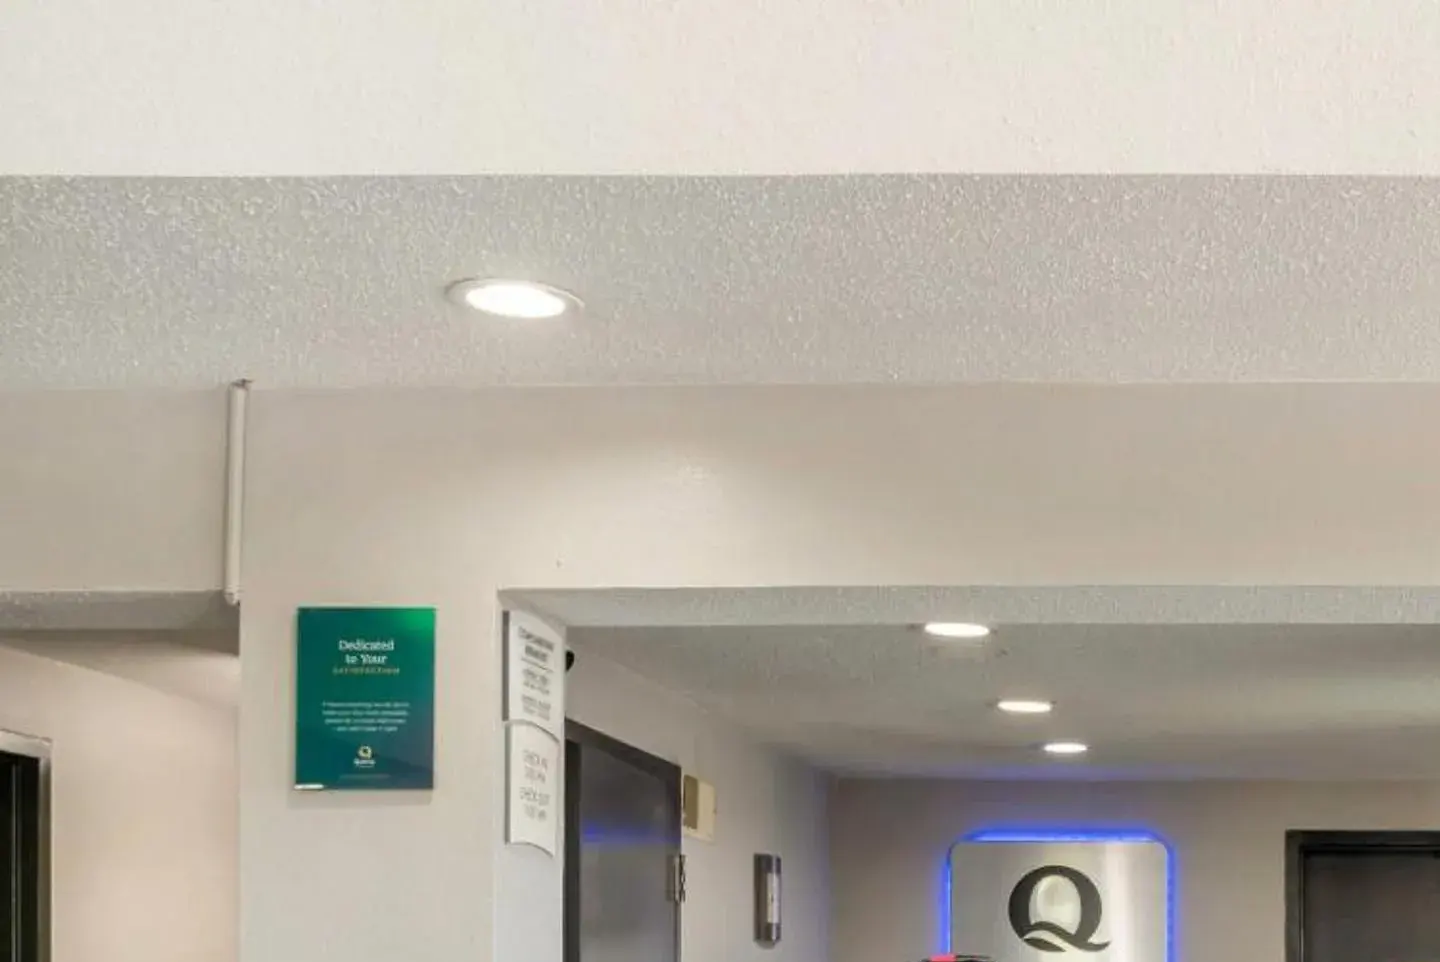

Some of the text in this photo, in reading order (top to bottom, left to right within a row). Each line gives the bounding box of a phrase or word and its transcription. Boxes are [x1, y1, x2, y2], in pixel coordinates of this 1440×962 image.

[339, 638, 395, 651] Dedicated
[345, 653, 388, 665] to Your
[1008, 864, 1111, 953] Q
